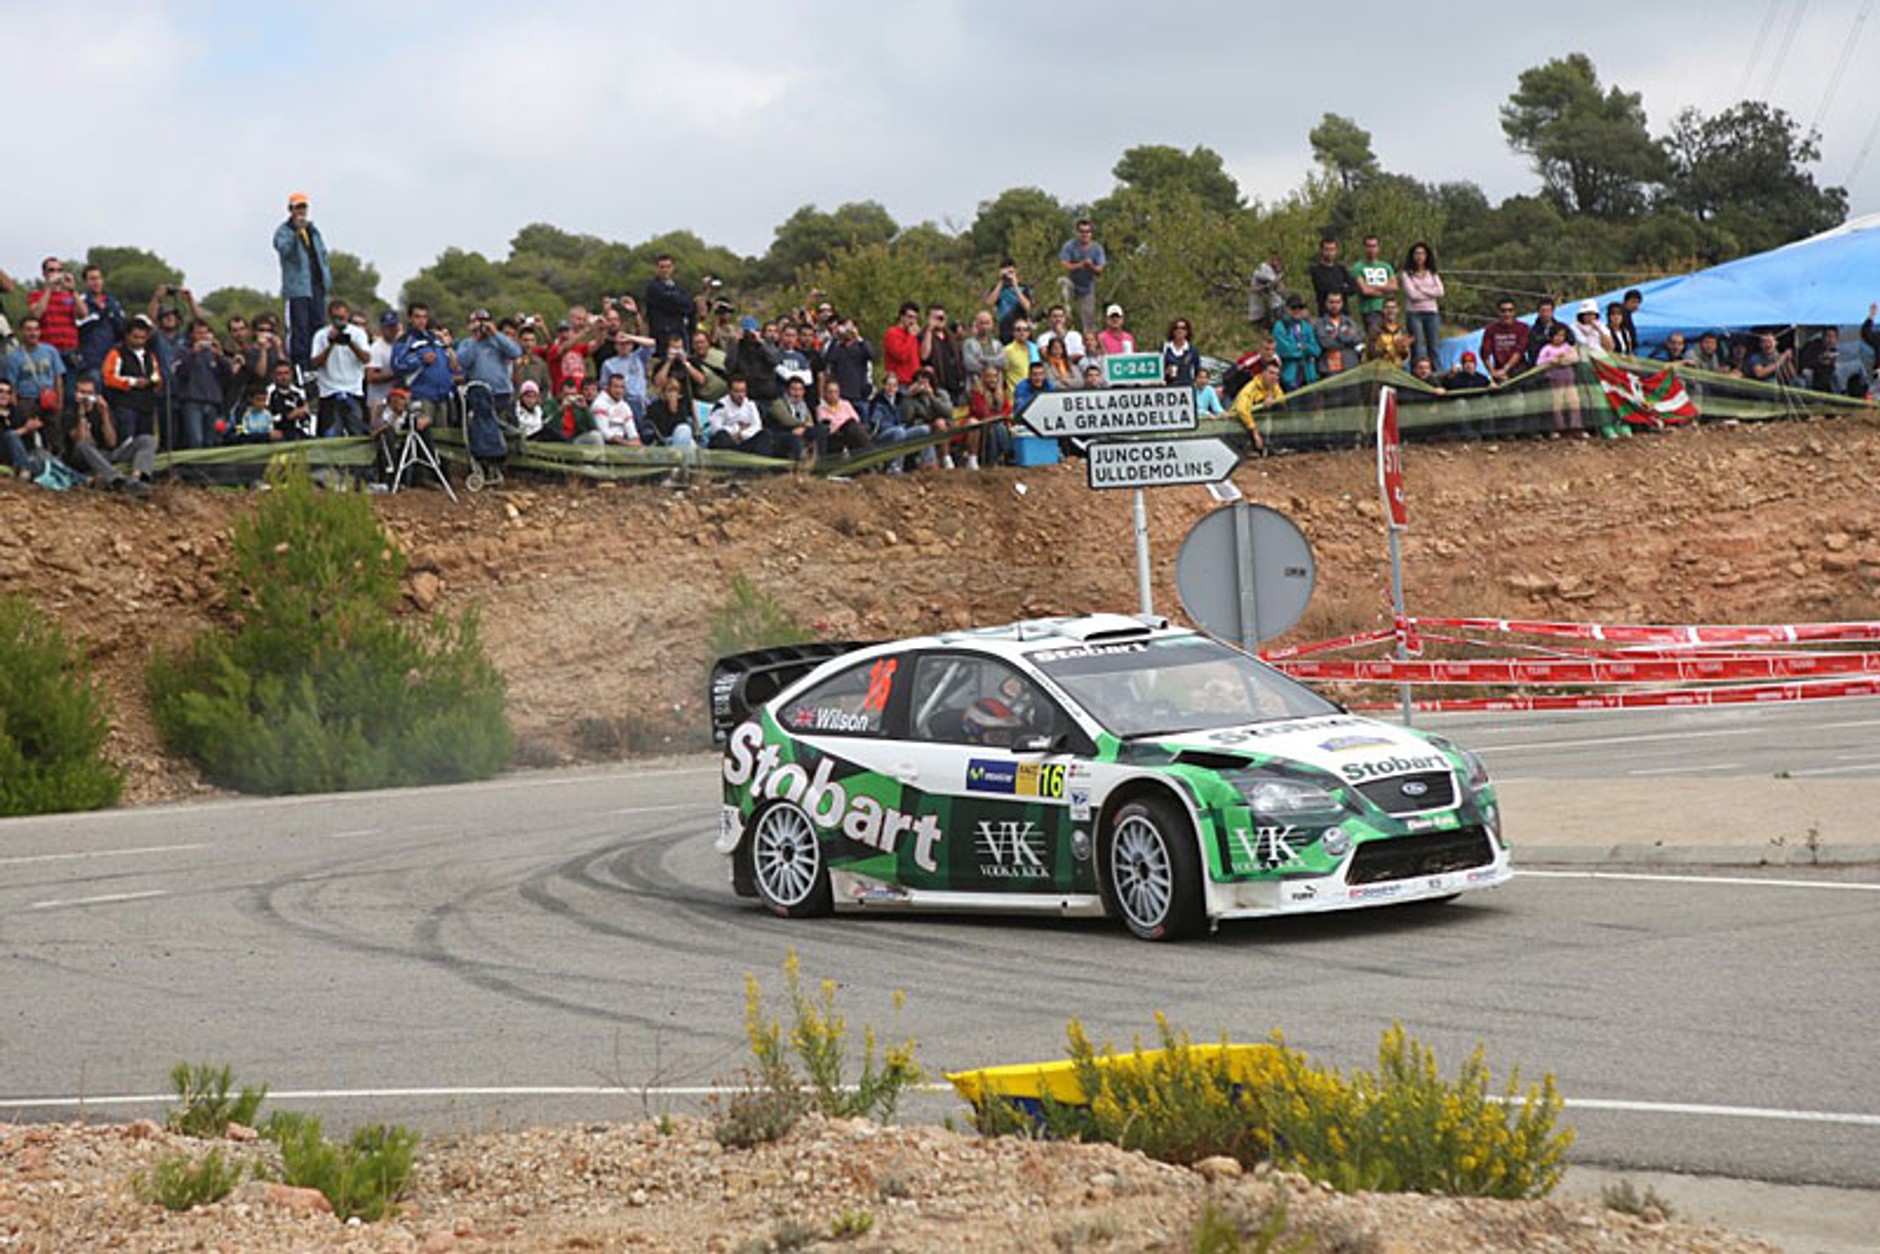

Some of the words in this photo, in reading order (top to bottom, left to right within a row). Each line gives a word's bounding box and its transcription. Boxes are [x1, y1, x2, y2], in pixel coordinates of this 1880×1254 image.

[1063, 392, 1190, 412] BELLAGUARDA
[1043, 416, 1066, 431] LA
[1075, 410, 1191, 430] GRANADELLA
[1095, 446, 1178, 464] JUNCOSA
[1095, 461, 1214, 482] ULLDEMOLINS
[815, 707, 869, 731] Wilson
[1041, 763, 1065, 799] 16
[1341, 754, 1449, 782] Stobart
[723, 721, 942, 873] Stobart
[977, 820, 1043, 866] VK
[1233, 824, 1301, 862] VK
